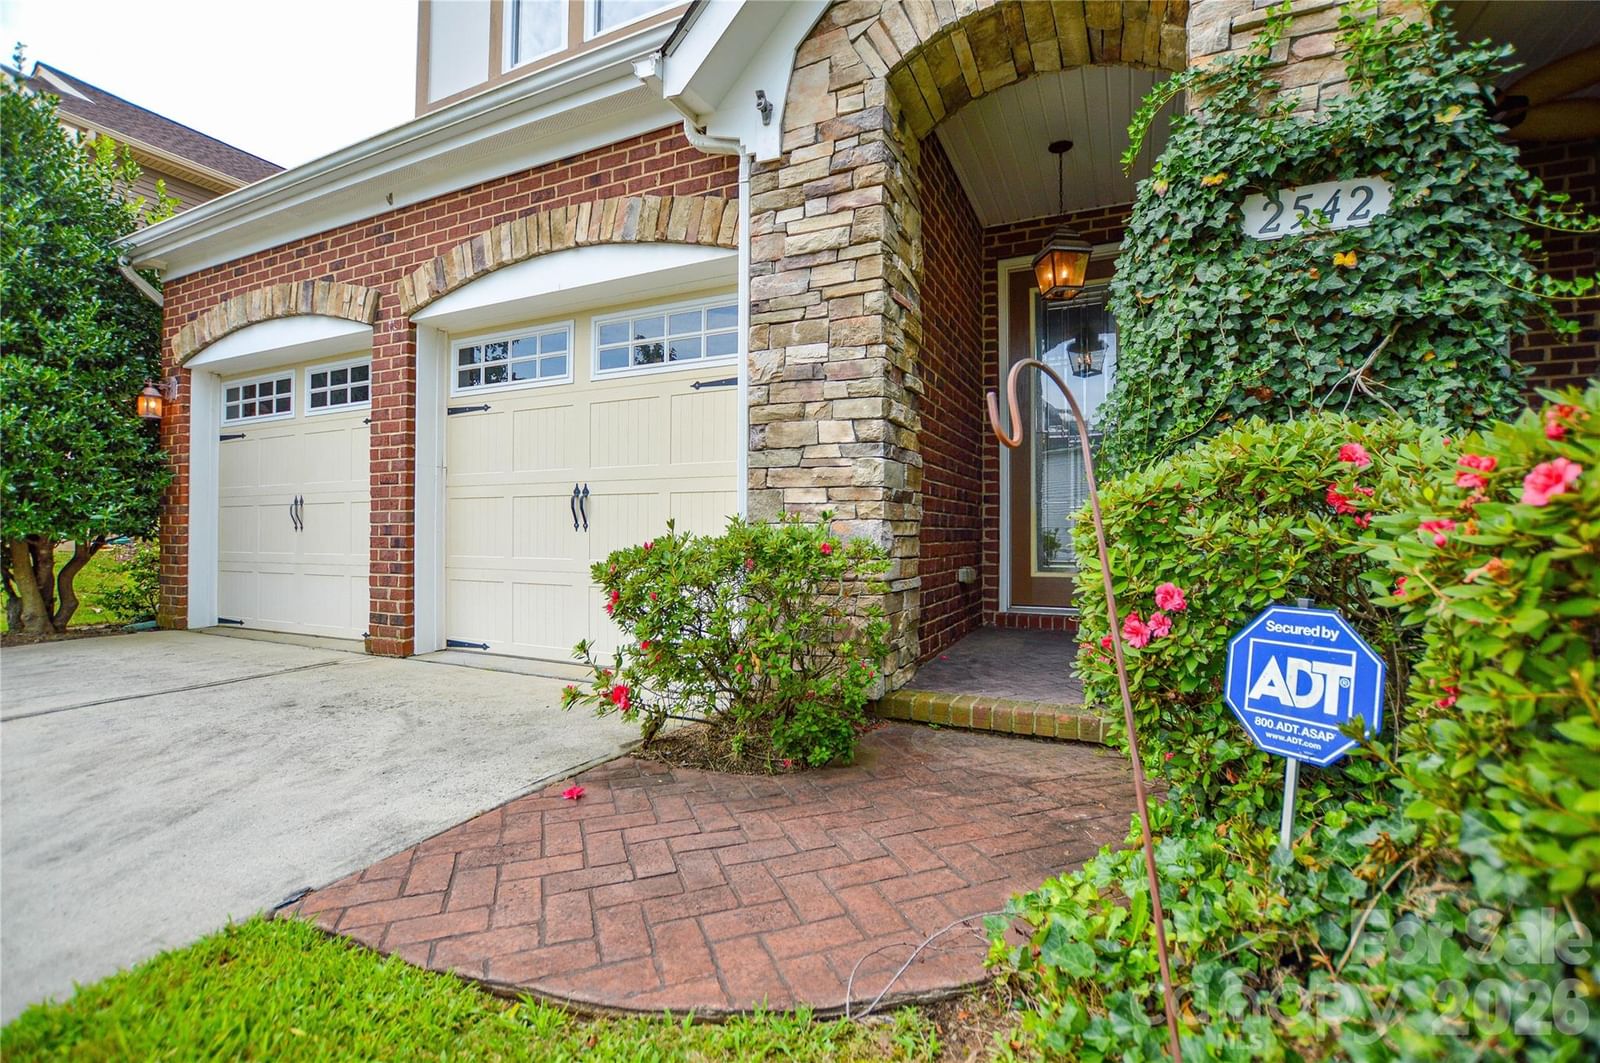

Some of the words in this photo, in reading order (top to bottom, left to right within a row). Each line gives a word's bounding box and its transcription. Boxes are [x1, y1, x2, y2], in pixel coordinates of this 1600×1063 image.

[1258, 185, 1374, 234] 2542
[1265, 619, 1320, 638] Secured
[1321, 625, 1340, 642] by
[1248, 655, 1352, 716] ADT
[1264, 731, 1322, 751] www.ADT.com
